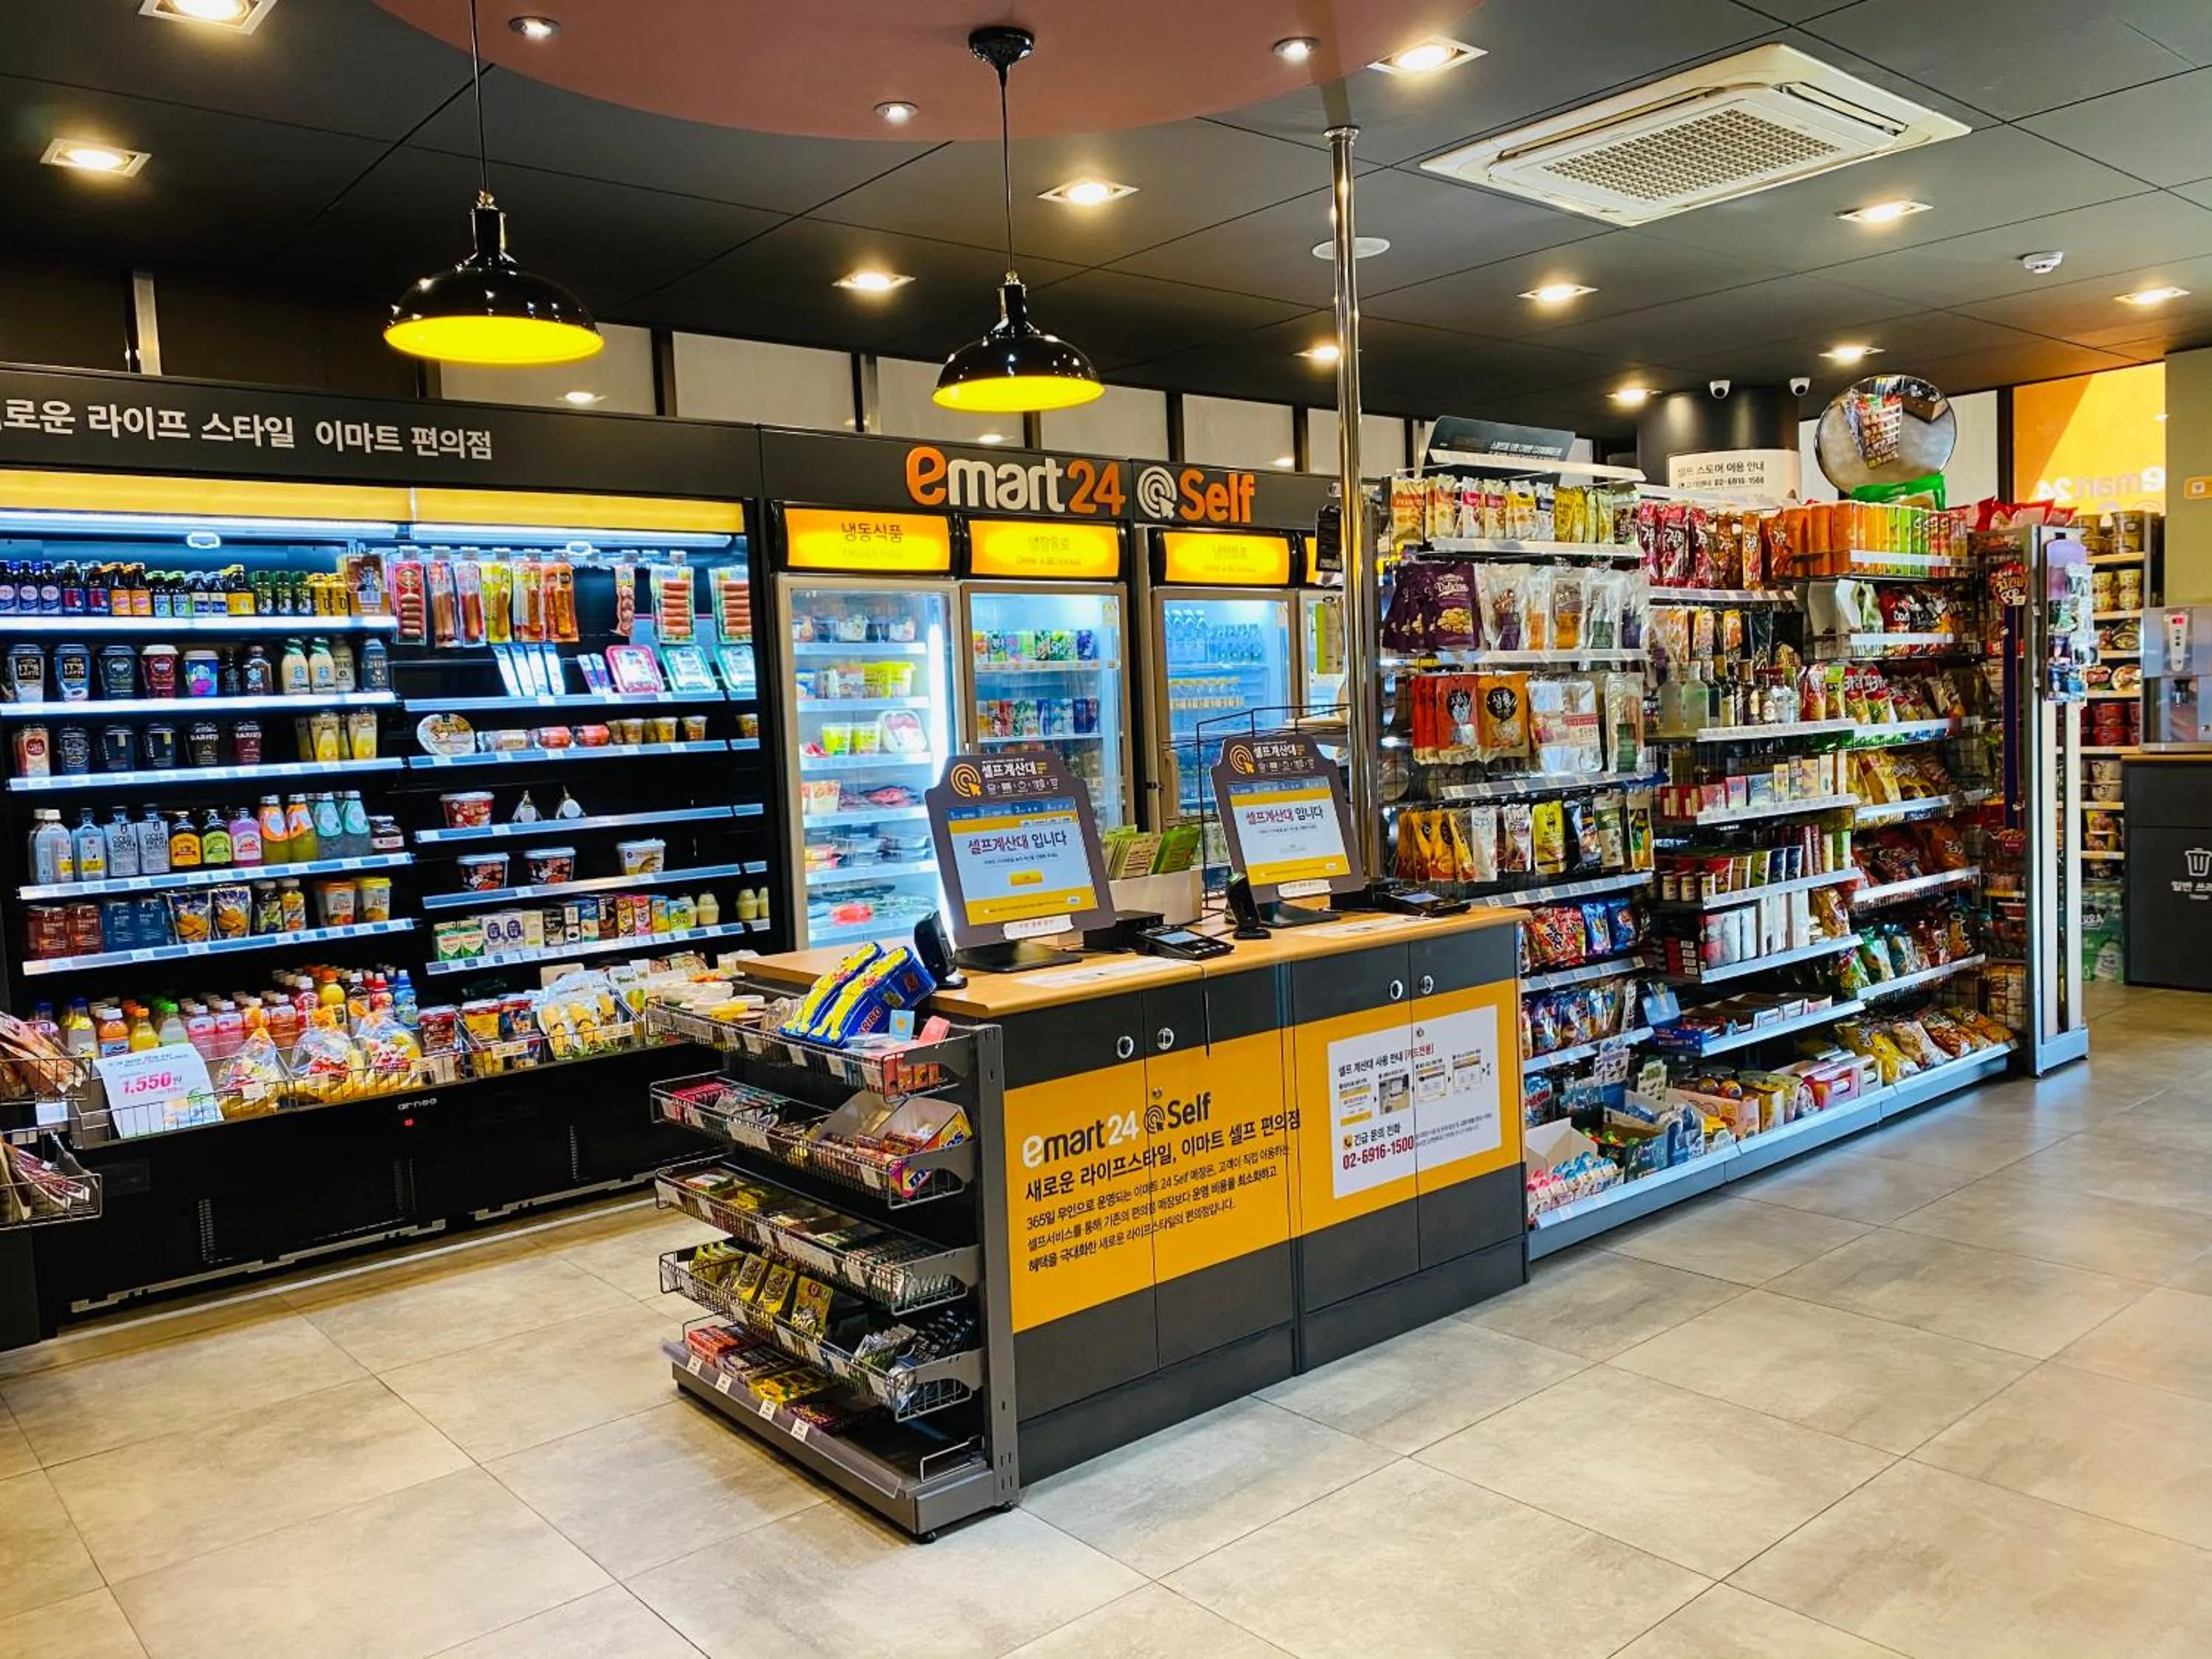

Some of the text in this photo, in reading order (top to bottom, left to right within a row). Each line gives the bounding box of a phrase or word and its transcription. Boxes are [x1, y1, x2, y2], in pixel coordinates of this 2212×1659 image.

[0, 398, 493, 460] 로운 라이프 스타일 이마트 편의점
[906, 446, 1126, 515] emart24
[841, 521, 904, 543] 냉동식품
[981, 761, 1037, 779] 셀프계산대
[1295, 805, 1324, 821] 입니다
[968, 830, 1067, 855] 셀프계산대 입니다
[1026, 1109, 1301, 1202] 새로운 라이프스타일, 이마트 셀프 편의점
[1343, 1135, 1414, 1170] 02-6916-1500
[1026, 1211, 1055, 1231] 365일
[1058, 1198, 1094, 1220] 무인으로
[1097, 1189, 1132, 1210] 운영되는
[1133, 1180, 1158, 1197] 이마트
[1160, 1177, 1172, 1190] 24
[1105, 1208, 1130, 1227] 기존의
[1192, 1185, 1209, 1201] 운영
[1099, 1232, 1124, 1249] 새로운
